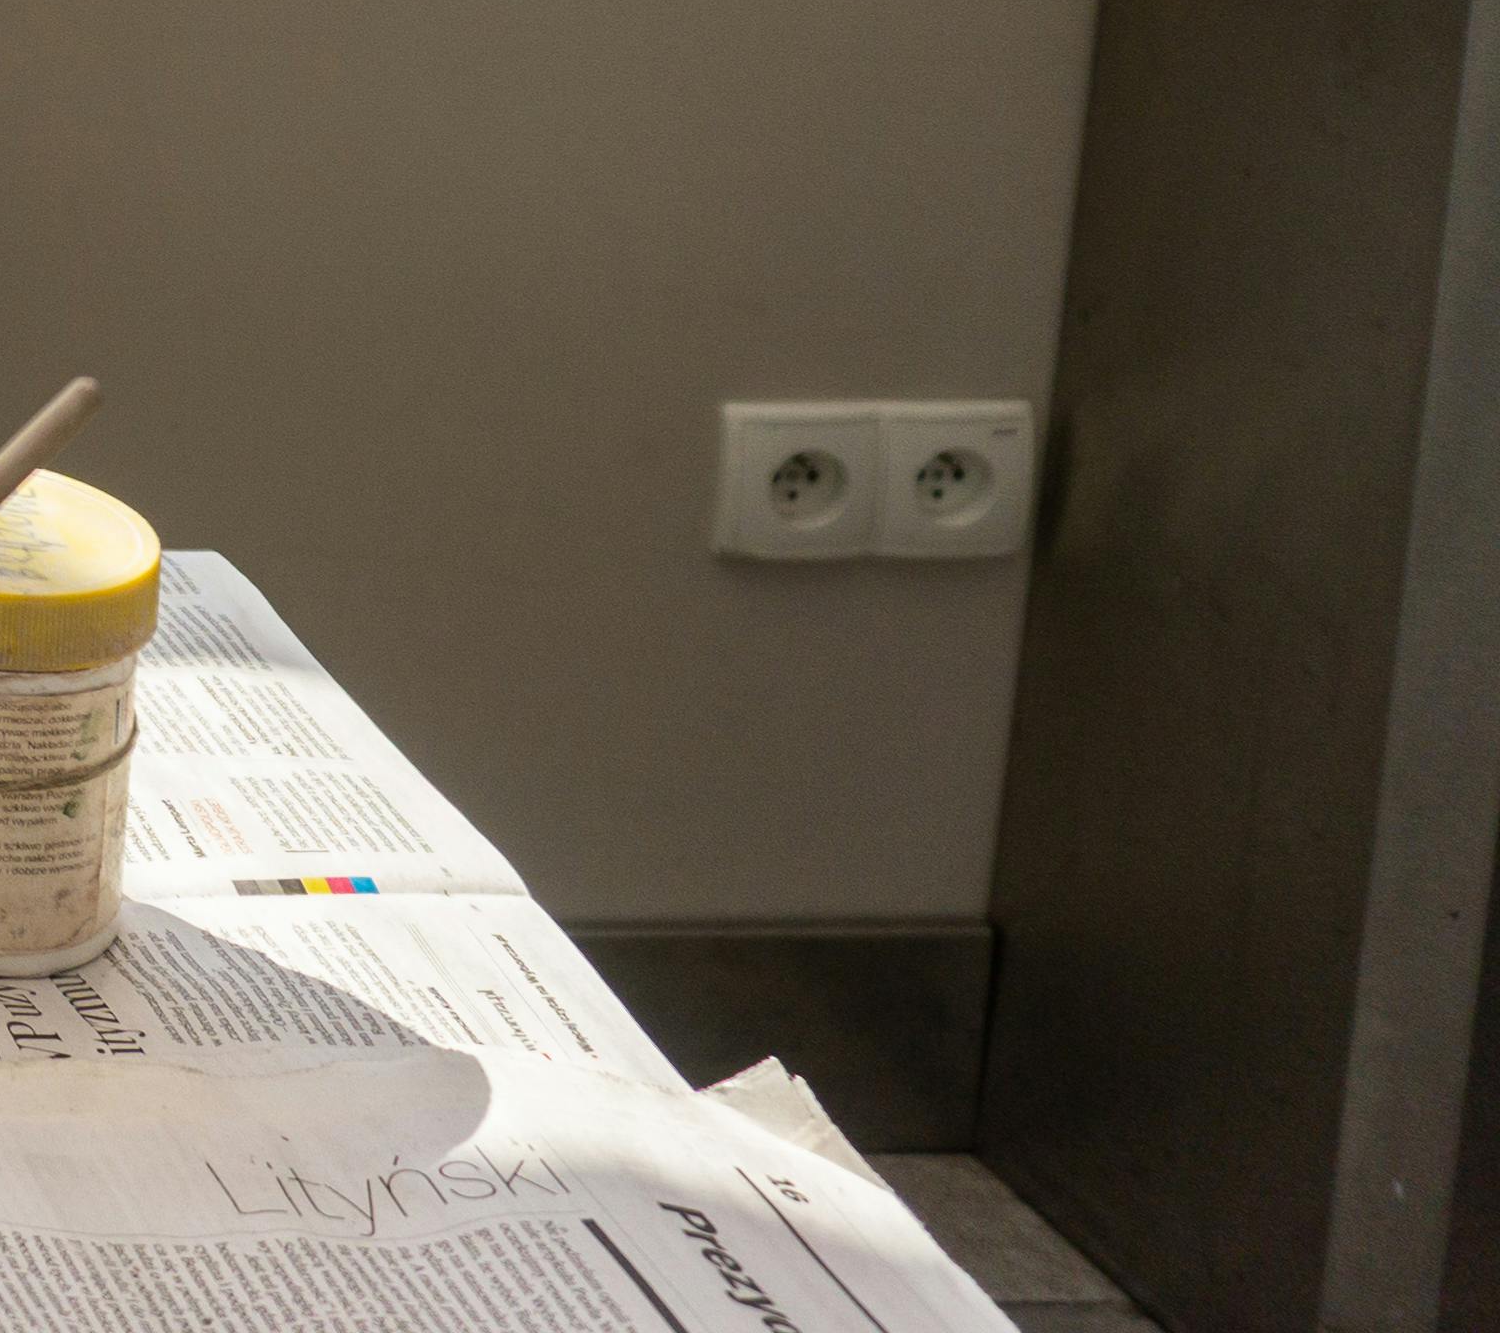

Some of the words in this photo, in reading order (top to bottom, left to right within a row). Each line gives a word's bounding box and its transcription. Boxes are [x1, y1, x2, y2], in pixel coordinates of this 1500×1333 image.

[51, 973, 148, 1056] ityzmu
[203, 1134, 572, 1237] Lityński
[765, 1172, 812, 1206] 16
